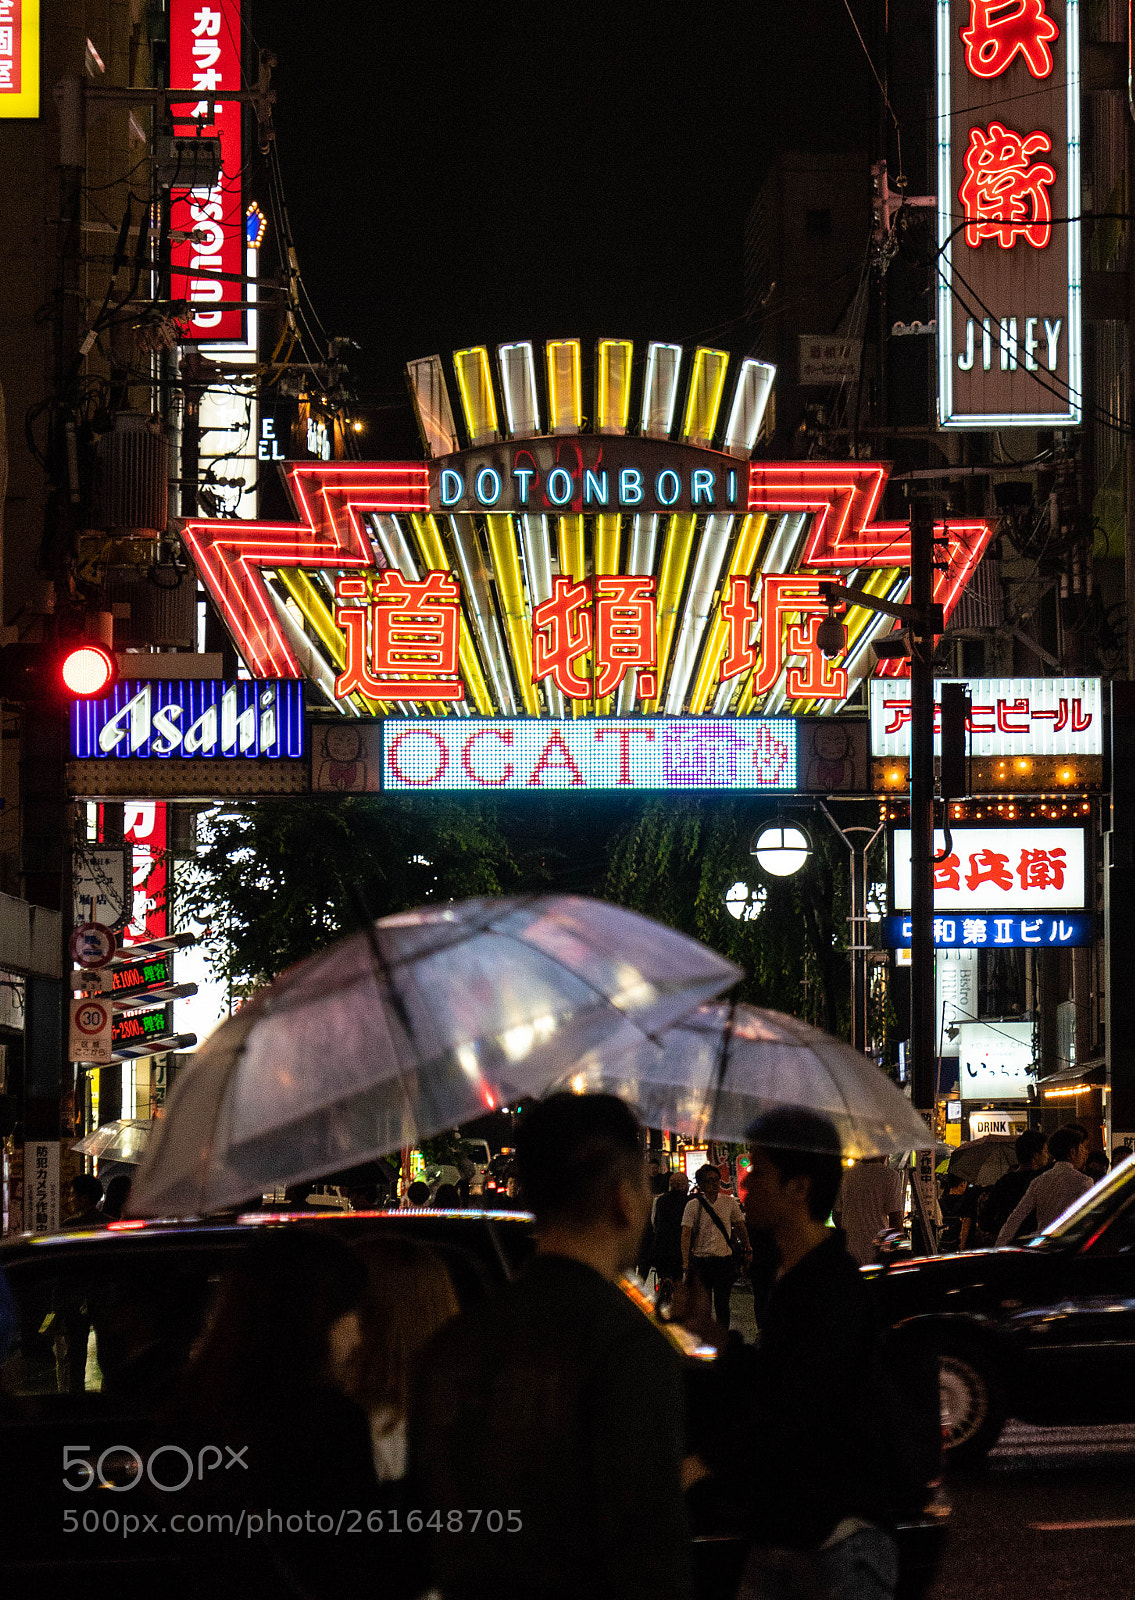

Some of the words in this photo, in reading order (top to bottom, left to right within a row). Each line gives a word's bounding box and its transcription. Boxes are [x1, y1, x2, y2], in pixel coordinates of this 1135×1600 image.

[957, 317, 1062, 371] JIHEY
[439, 467, 737, 506] DOTONBORI
[335, 569, 848, 702] 道頓堀
[98, 683, 277, 753] Asahi
[883, 697, 1093, 734] アヒビール
[387, 727, 656, 786] OCAT
[959, 969, 972, 1006] Bistro
[83, 1011, 100, 1026] 30
[977, 1121, 1006, 1133] DRINK
[35, 1145, 48, 1232] 防犯カメラ作動中
